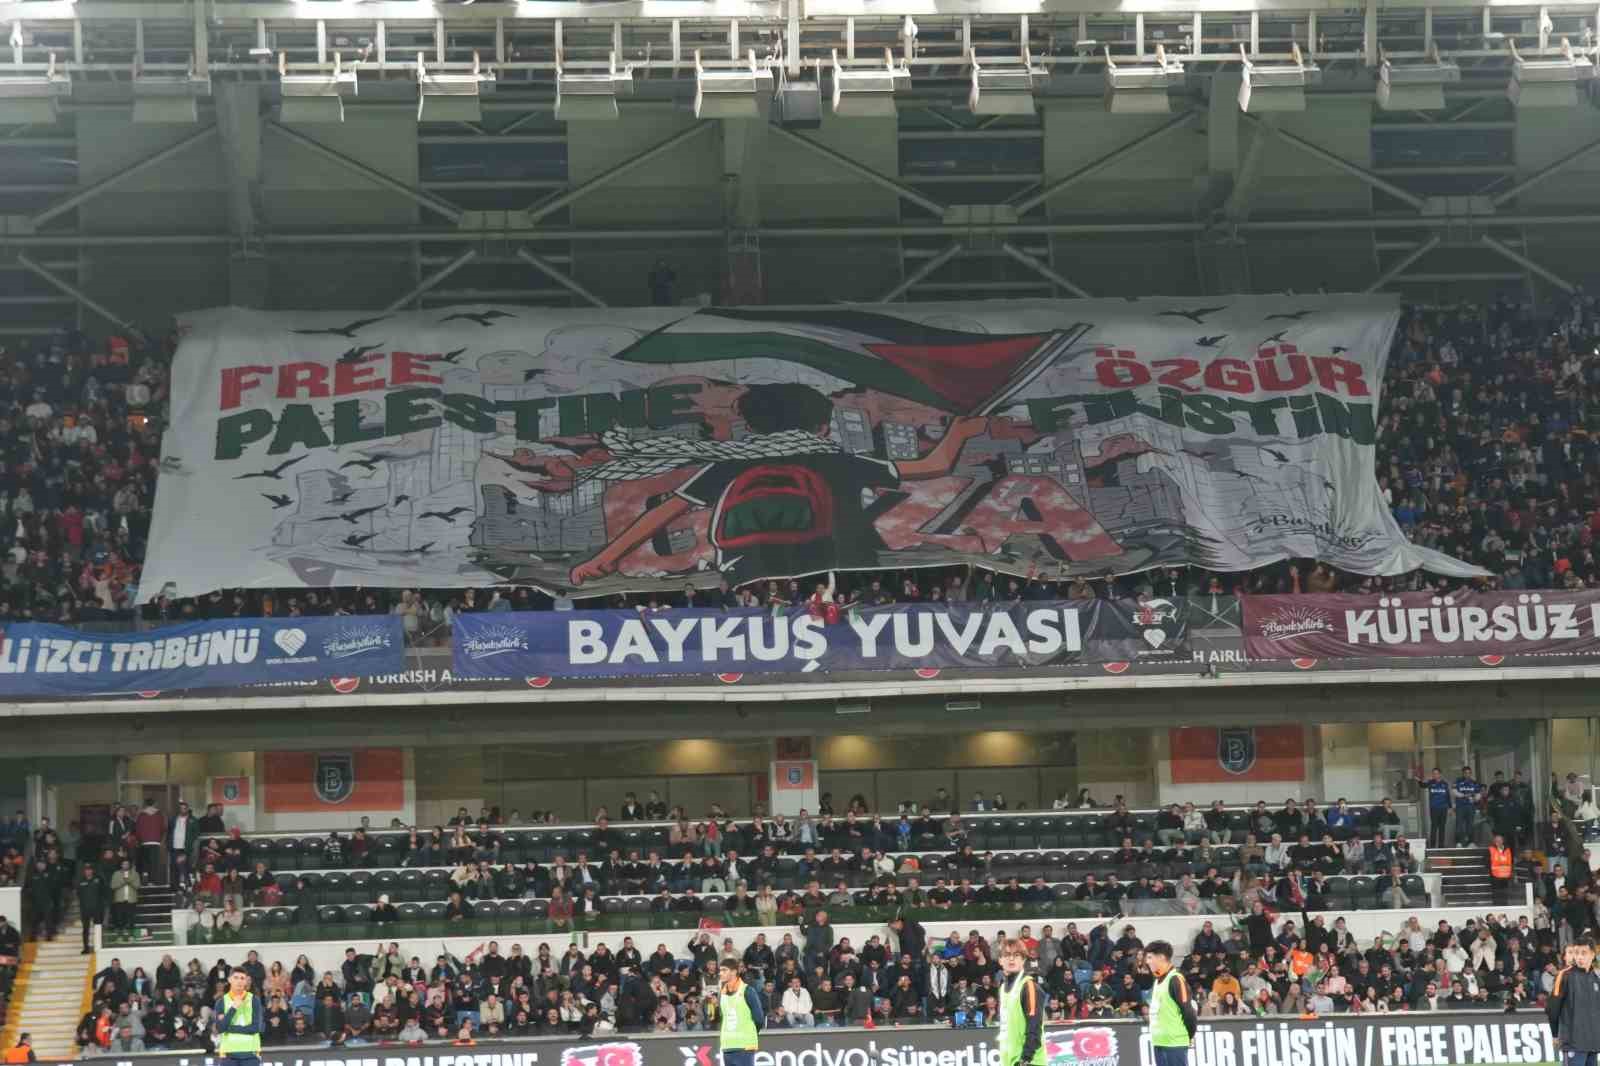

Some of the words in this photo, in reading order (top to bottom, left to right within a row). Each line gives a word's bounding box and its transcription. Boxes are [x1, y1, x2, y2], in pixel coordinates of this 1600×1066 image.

[219, 351, 444, 410] FREE
[1095, 343, 1371, 397] ÖZGÜR
[214, 383, 703, 460] PALESTINE
[568, 613, 828, 673] BAYKUŞ
[849, 608, 1081, 658] YUVASI
[1344, 592, 1580, 644] KÜFÜRSÜZ
[111, 628, 262, 673] TRİBÜNÜ
[1241, 1021, 1358, 1066] FİLİSTİN
[1380, 1025, 1449, 1066] FREE
[1453, 1023, 1563, 1064] PALEST
